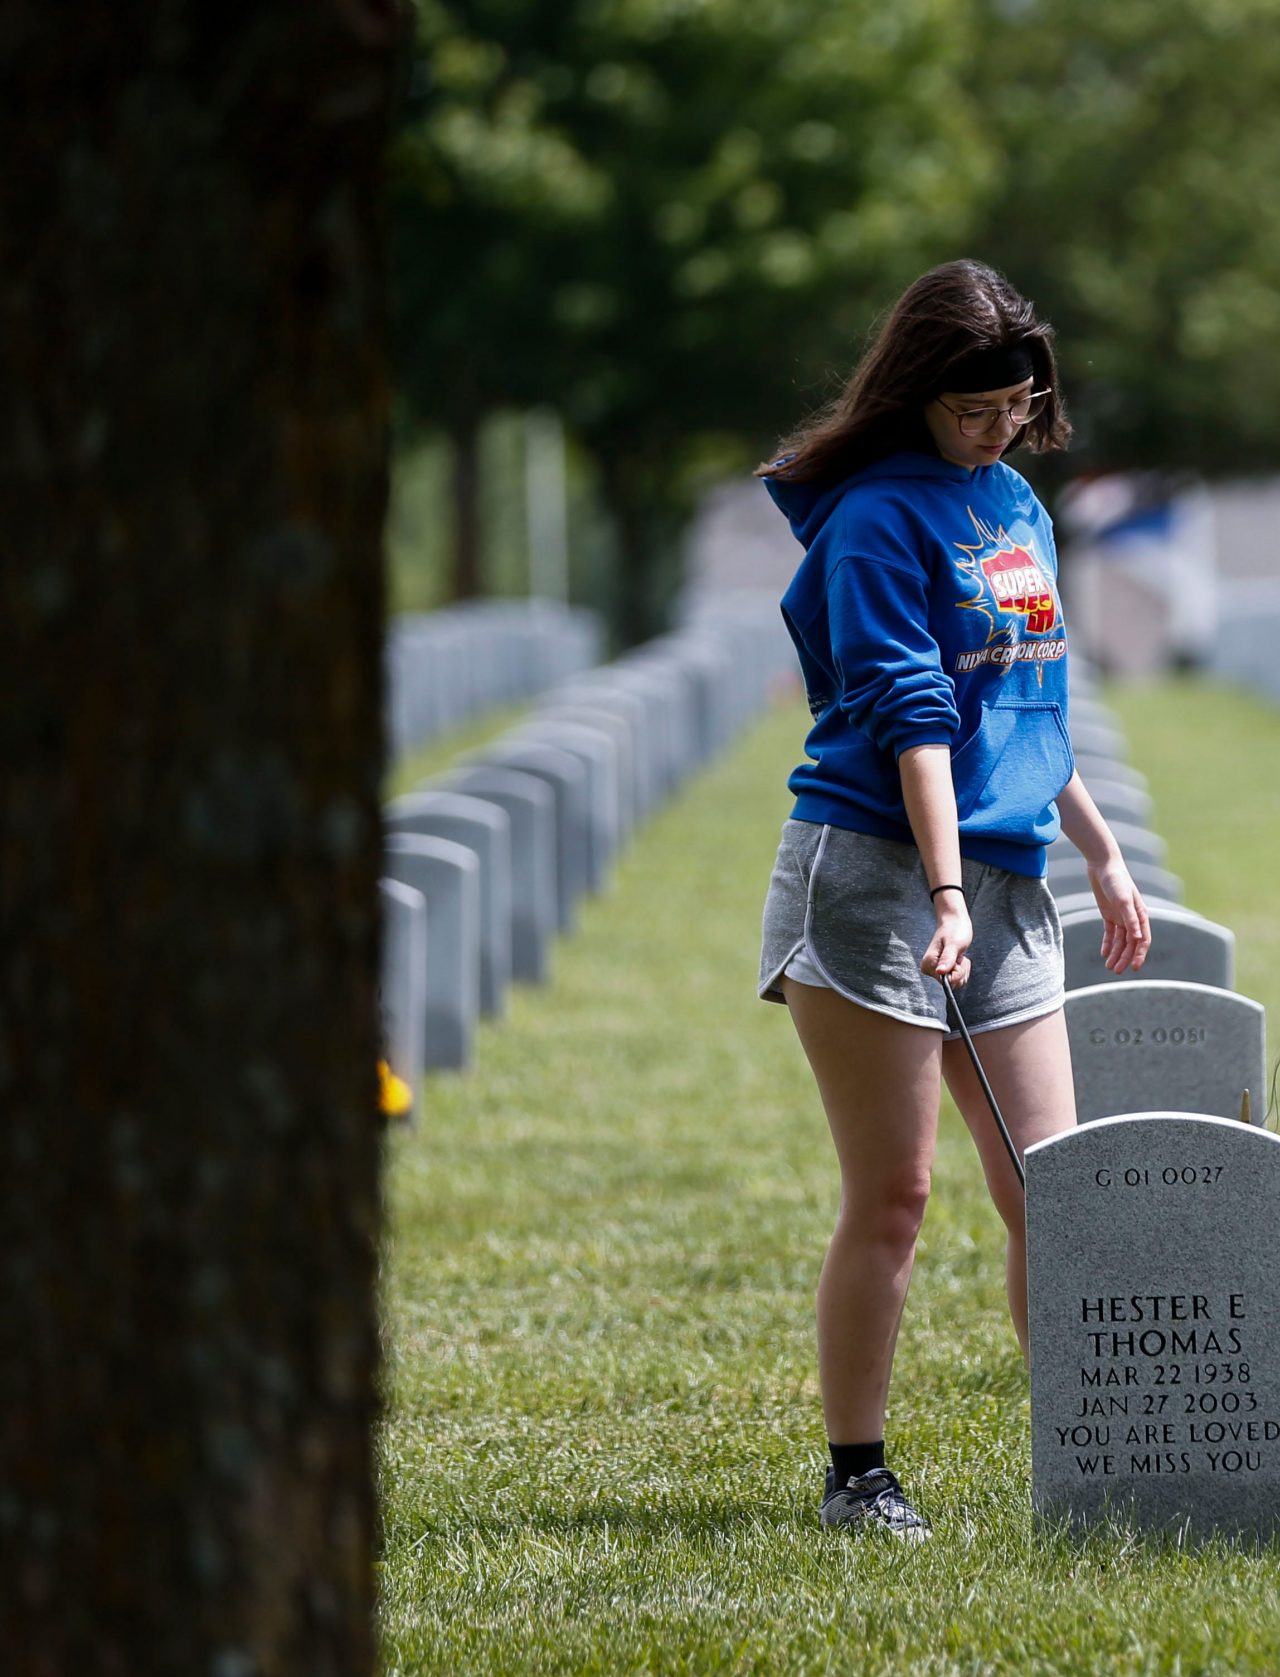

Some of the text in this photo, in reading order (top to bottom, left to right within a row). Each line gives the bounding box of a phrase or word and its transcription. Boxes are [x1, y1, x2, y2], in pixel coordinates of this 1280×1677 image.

[990, 567, 1047, 599] SUPER
[1037, 640, 1065, 660] CORP
[1088, 1027, 1106, 1045] G
[1095, 1168, 1111, 1188] G
[1162, 1166, 1225, 1186] 0027
[1081, 1293, 1246, 1323] HESTER E
[1087, 1328, 1243, 1358] THOMAS
[1081, 1362, 1252, 1388] MAR 22 1938
[1075, 1392, 1258, 1417] JAN 27 2003
[1055, 1424, 1111, 1447] YOU
[1126, 1423, 1176, 1445] ARE
[1076, 1450, 1262, 1476] WE MISS YOU
